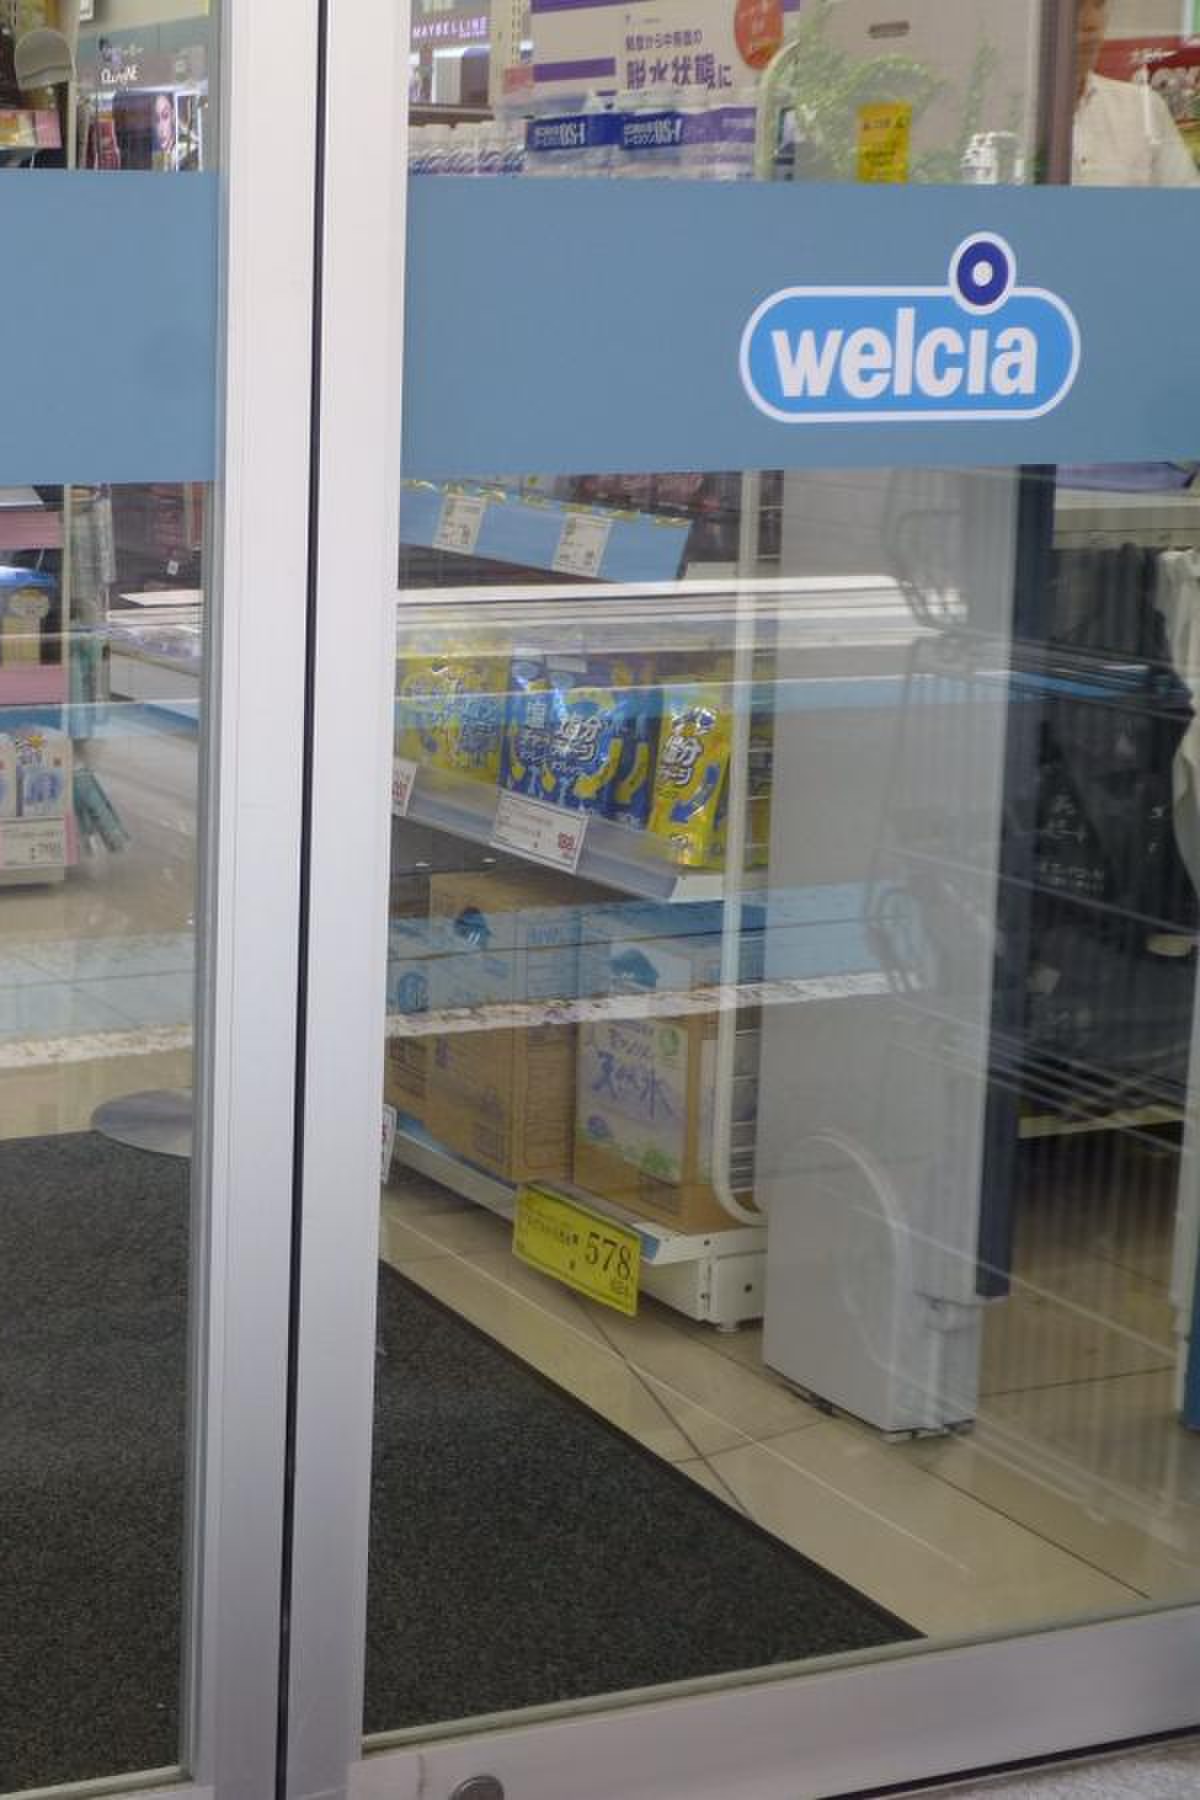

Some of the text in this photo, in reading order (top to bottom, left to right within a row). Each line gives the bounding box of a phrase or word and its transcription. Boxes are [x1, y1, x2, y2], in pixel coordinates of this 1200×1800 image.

[413, 16, 487, 39] MAYBELLINE
[626, 53, 733, 91] 脱水状態に
[770, 306, 1038, 399] welcia
[585, 1231, 631, 1281] 578
